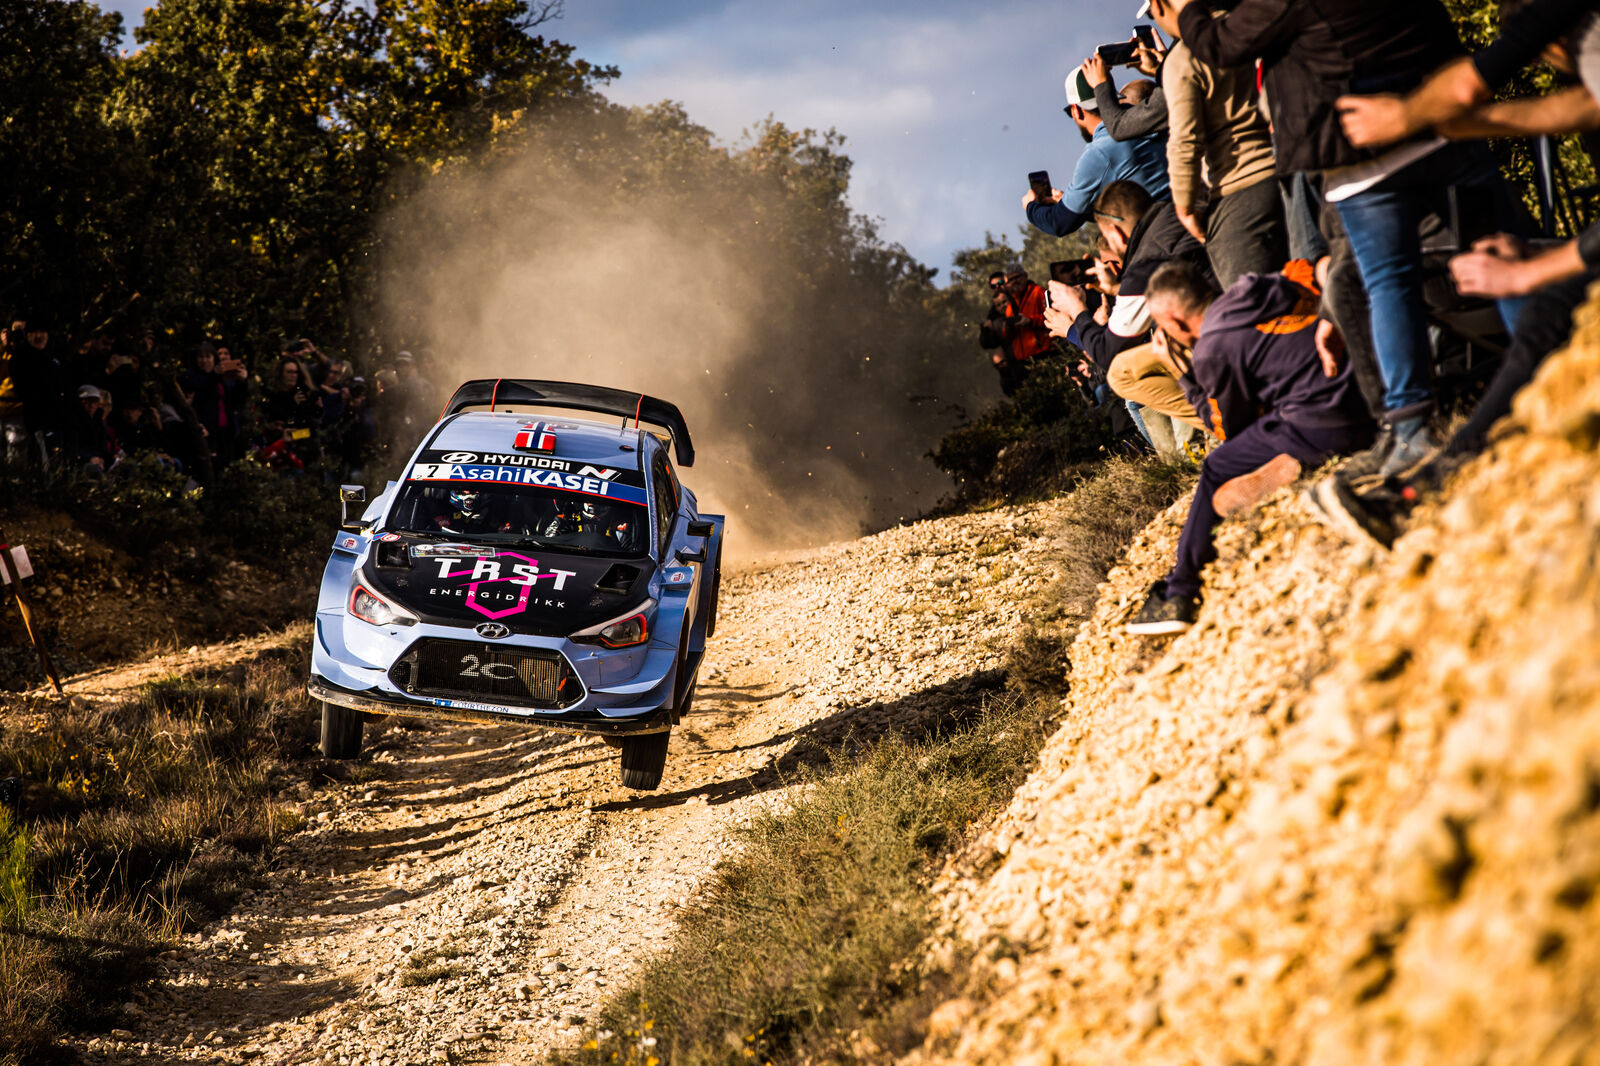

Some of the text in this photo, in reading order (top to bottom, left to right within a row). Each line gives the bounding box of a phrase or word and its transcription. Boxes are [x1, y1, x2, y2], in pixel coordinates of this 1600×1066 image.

[427, 465, 439, 477] 7
[483, 454, 570, 471] HYUNDAI
[434, 558, 576, 591] TRST
